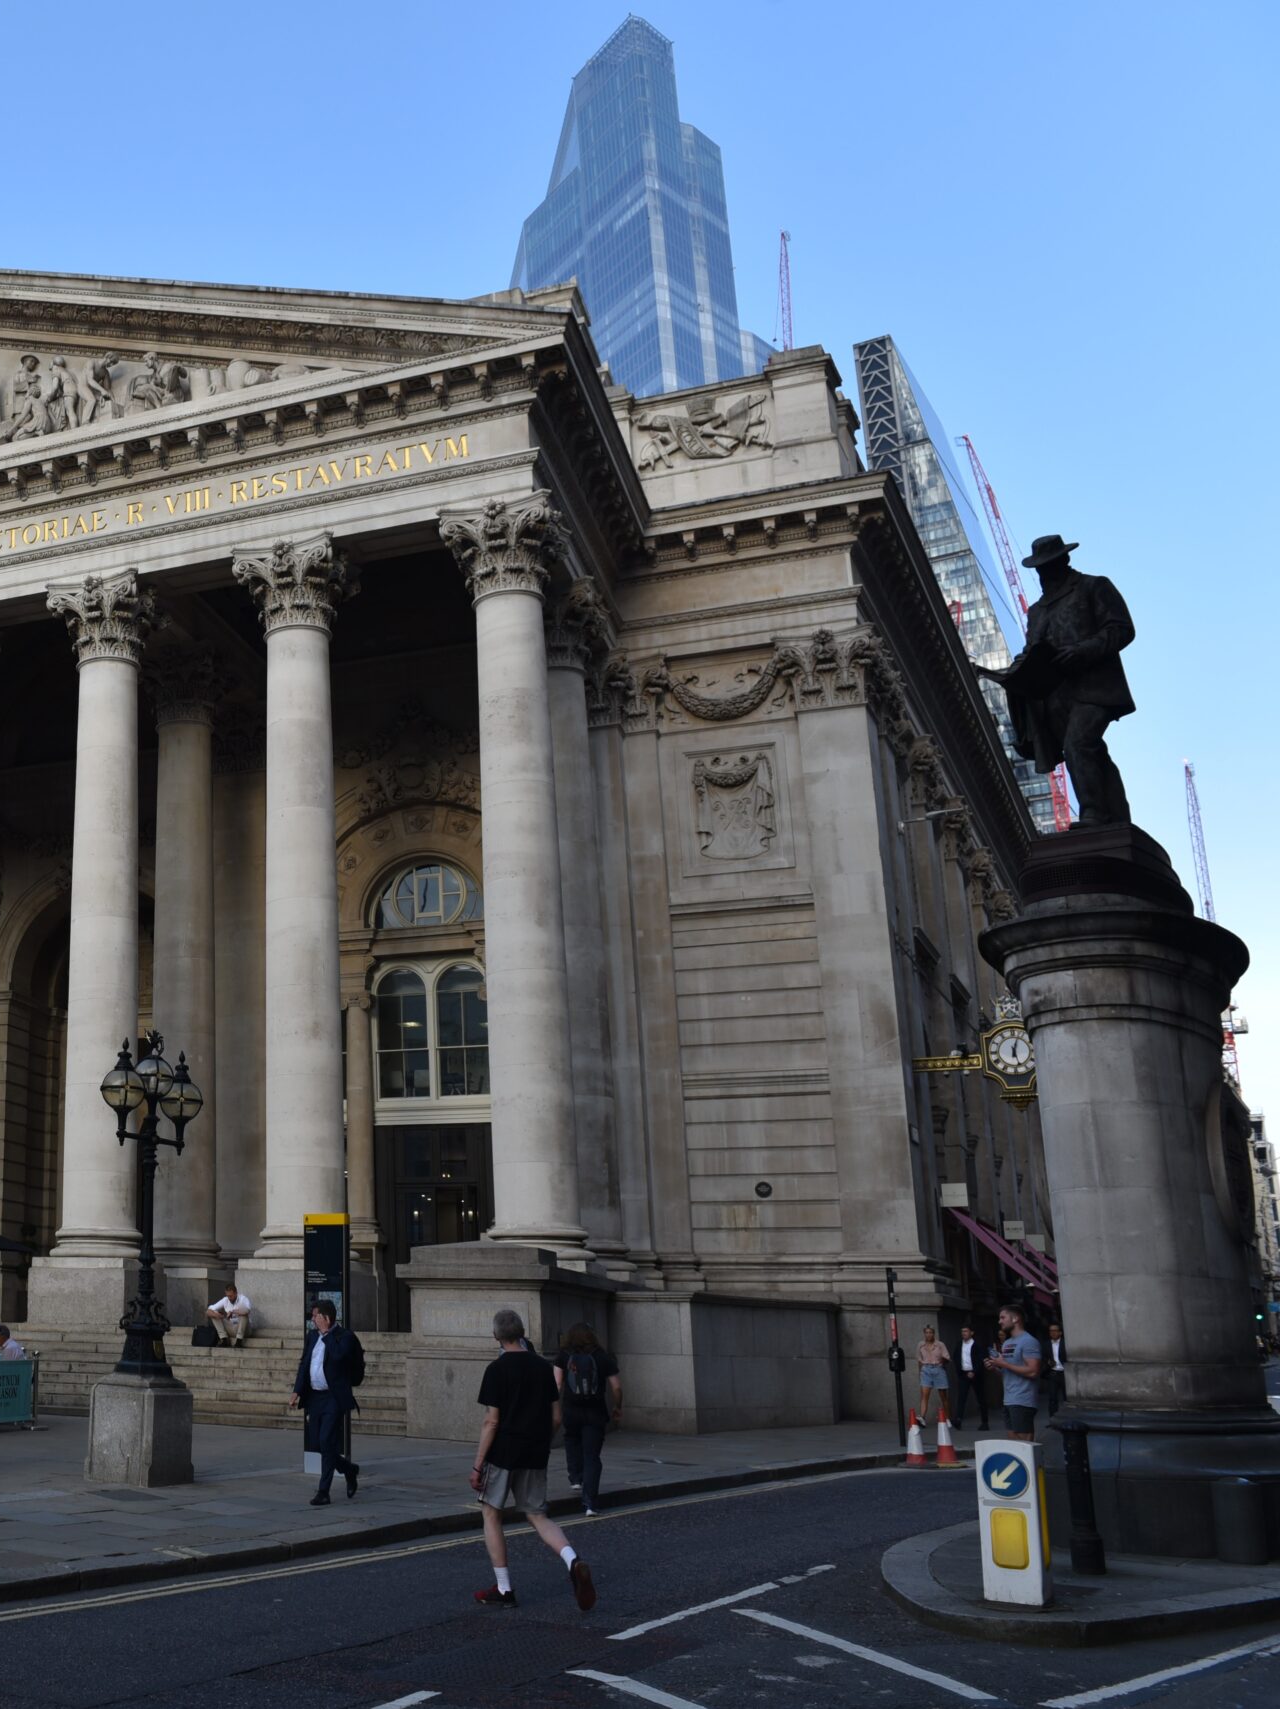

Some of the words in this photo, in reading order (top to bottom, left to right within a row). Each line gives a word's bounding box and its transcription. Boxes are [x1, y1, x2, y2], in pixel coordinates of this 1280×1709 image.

[126, 500, 145, 526] R
[163, 486, 211, 516] VIII
[229, 434, 470, 504] RESTAVRATVM
